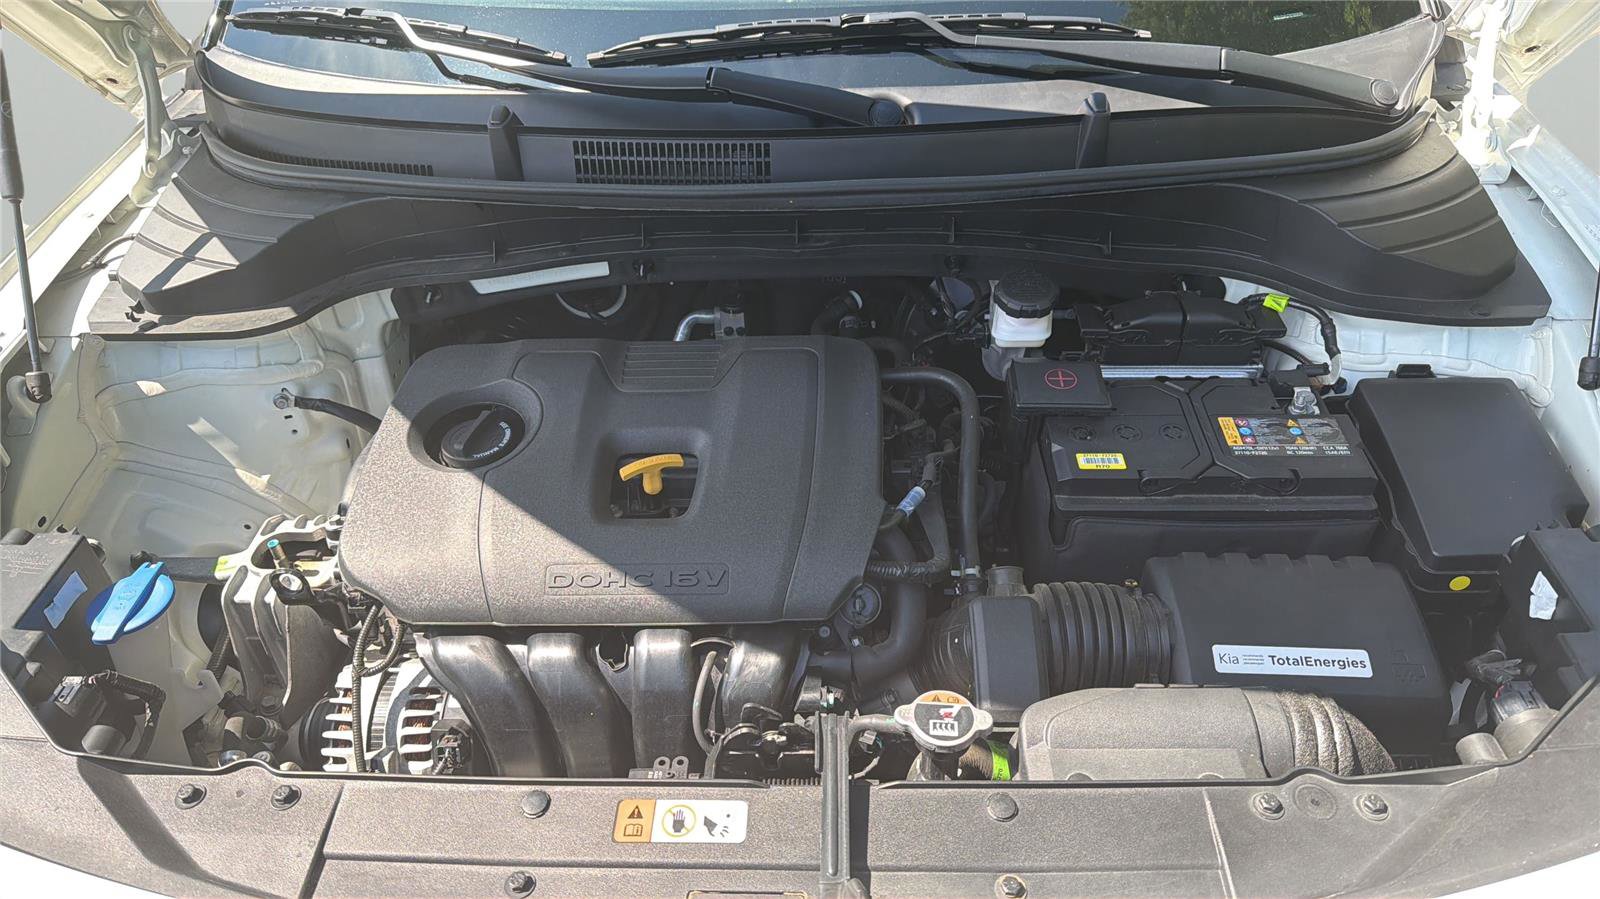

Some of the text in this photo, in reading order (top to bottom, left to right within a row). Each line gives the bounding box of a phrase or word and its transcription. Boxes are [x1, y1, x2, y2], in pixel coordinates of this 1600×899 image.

[548, 570, 655, 588] DOHC
[1218, 653, 1367, 670] Kia TotalEnergies
